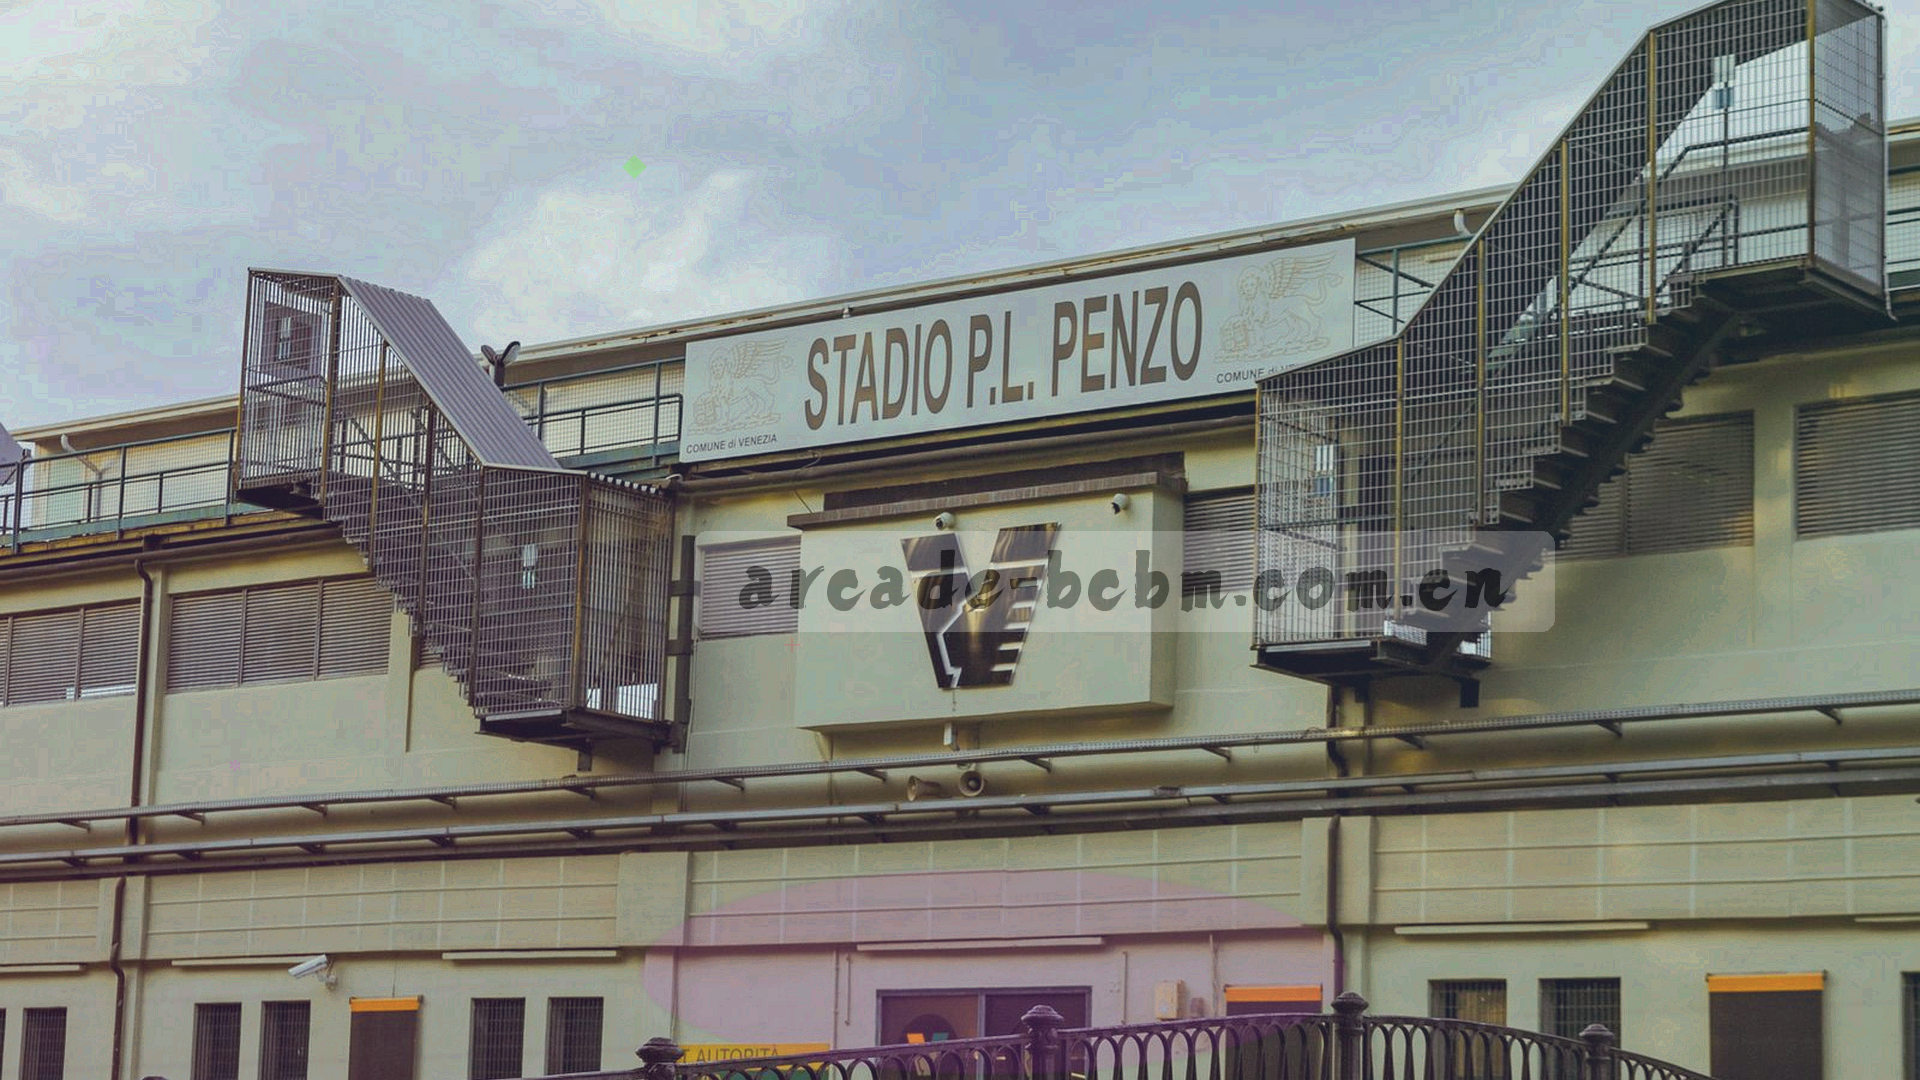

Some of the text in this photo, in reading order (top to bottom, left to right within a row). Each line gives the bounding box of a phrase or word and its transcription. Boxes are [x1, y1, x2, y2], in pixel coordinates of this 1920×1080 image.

[805, 281, 1202, 430] STADIO P.L. PENZO
[686, 433, 777, 454] COMUNE di VENEZIA
